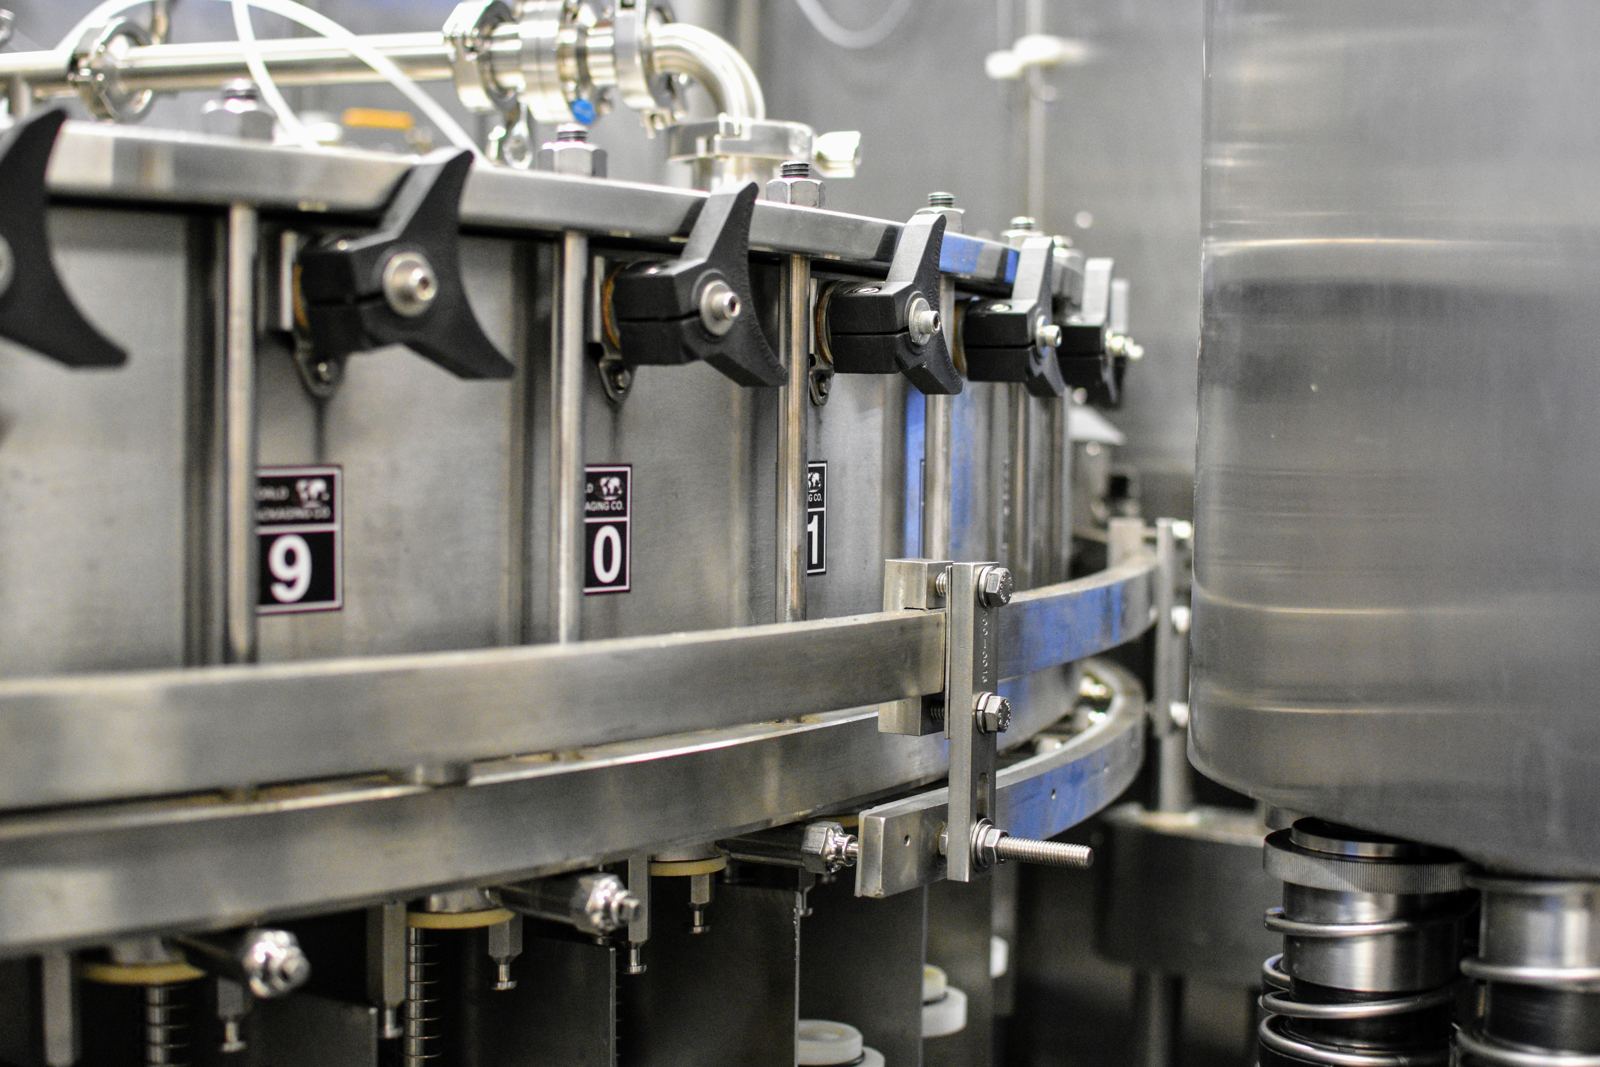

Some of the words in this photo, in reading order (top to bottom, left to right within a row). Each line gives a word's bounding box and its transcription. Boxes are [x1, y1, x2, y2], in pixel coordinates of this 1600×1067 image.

[585, 501, 610, 511] AGING
[593, 525, 621, 583] 0
[807, 515, 818, 564] 1
[268, 534, 312, 602] 9
